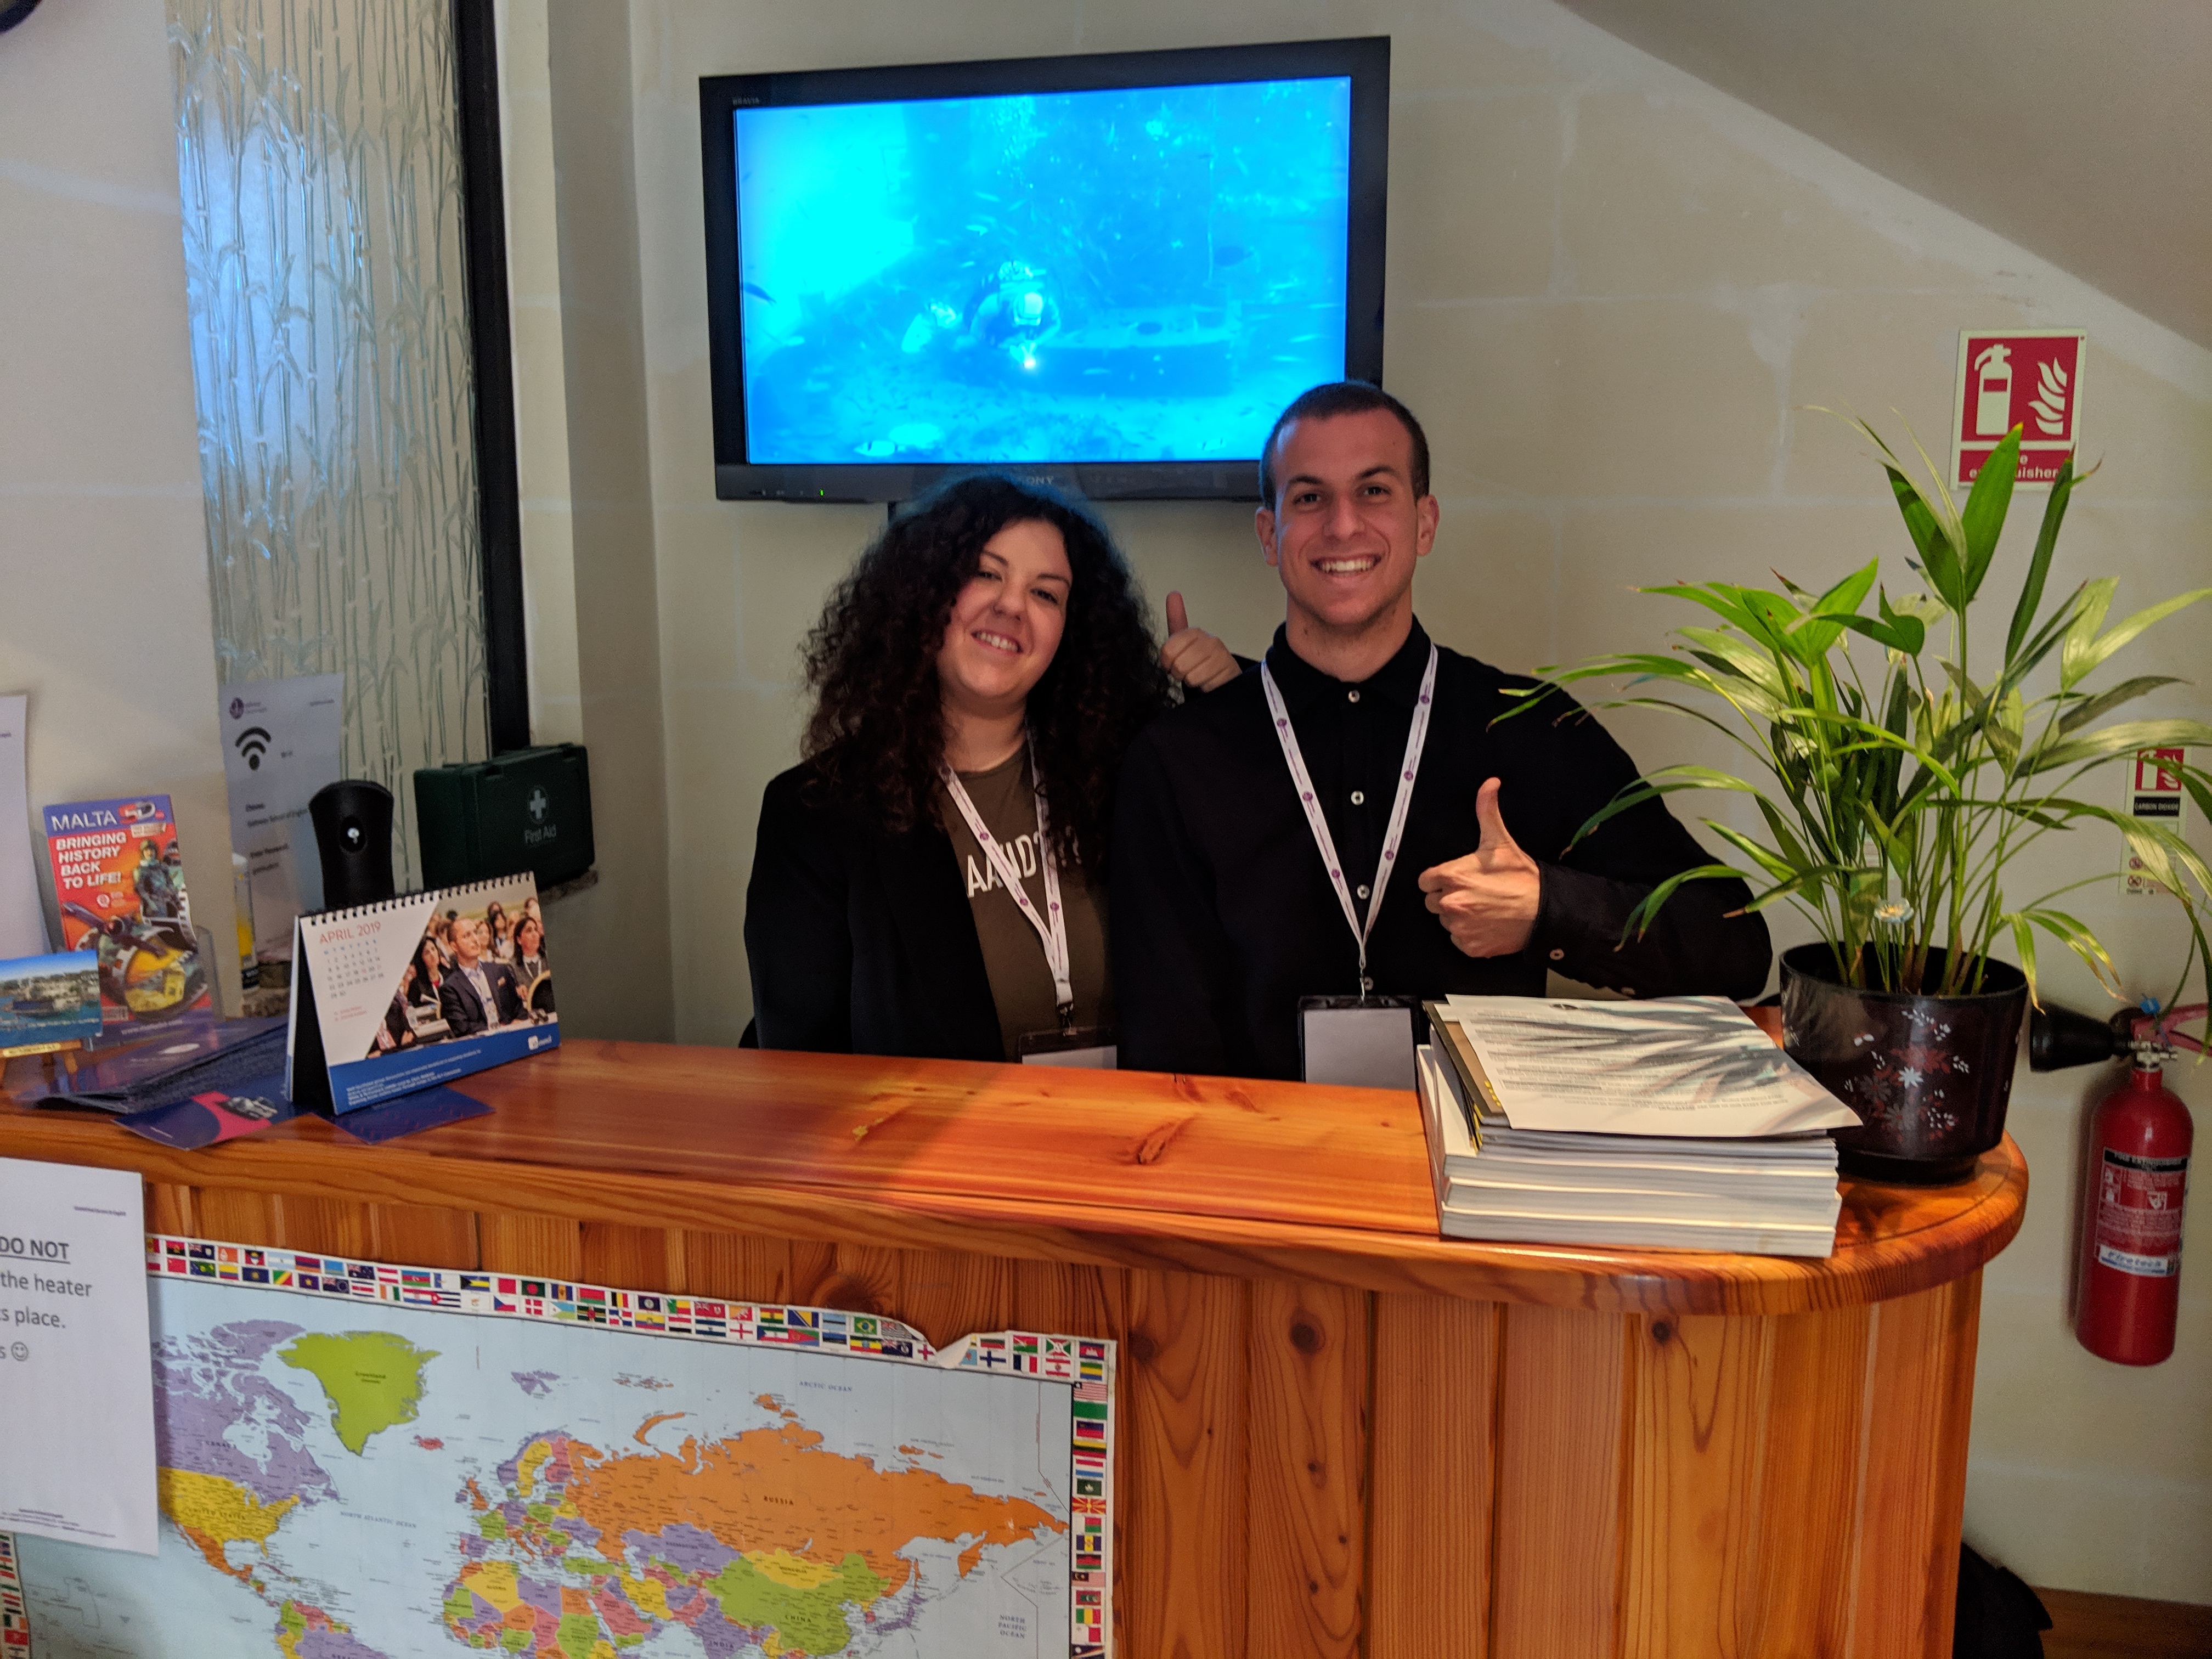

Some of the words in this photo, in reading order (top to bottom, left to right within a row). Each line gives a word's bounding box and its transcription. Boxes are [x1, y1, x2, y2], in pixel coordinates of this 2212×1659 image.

[51, 810, 117, 832] MALTA
[56, 832, 127, 851] BRINGING
[59, 845, 121, 864] HISTORY
[61, 861, 101, 877] BACK
[63, 876, 83, 890] TO
[87, 871, 122, 887] LIFE!
[320, 928, 354, 944] APRIL
[357, 921, 381, 936] 2019
[30, 1240, 69, 1260] NOT
[0, 1270, 29, 1290] the
[34, 1273, 93, 1297] heater
[15, 1306, 66, 1328] place.
[764, 1494, 794, 1505] RUSSIA
[785, 1615, 812, 1623] CHINA
[997, 1622, 1028, 1632] PACIFIC
[999, 1614, 1026, 1624] NORTH
[1000, 1629, 1025, 1639] OCEAN
